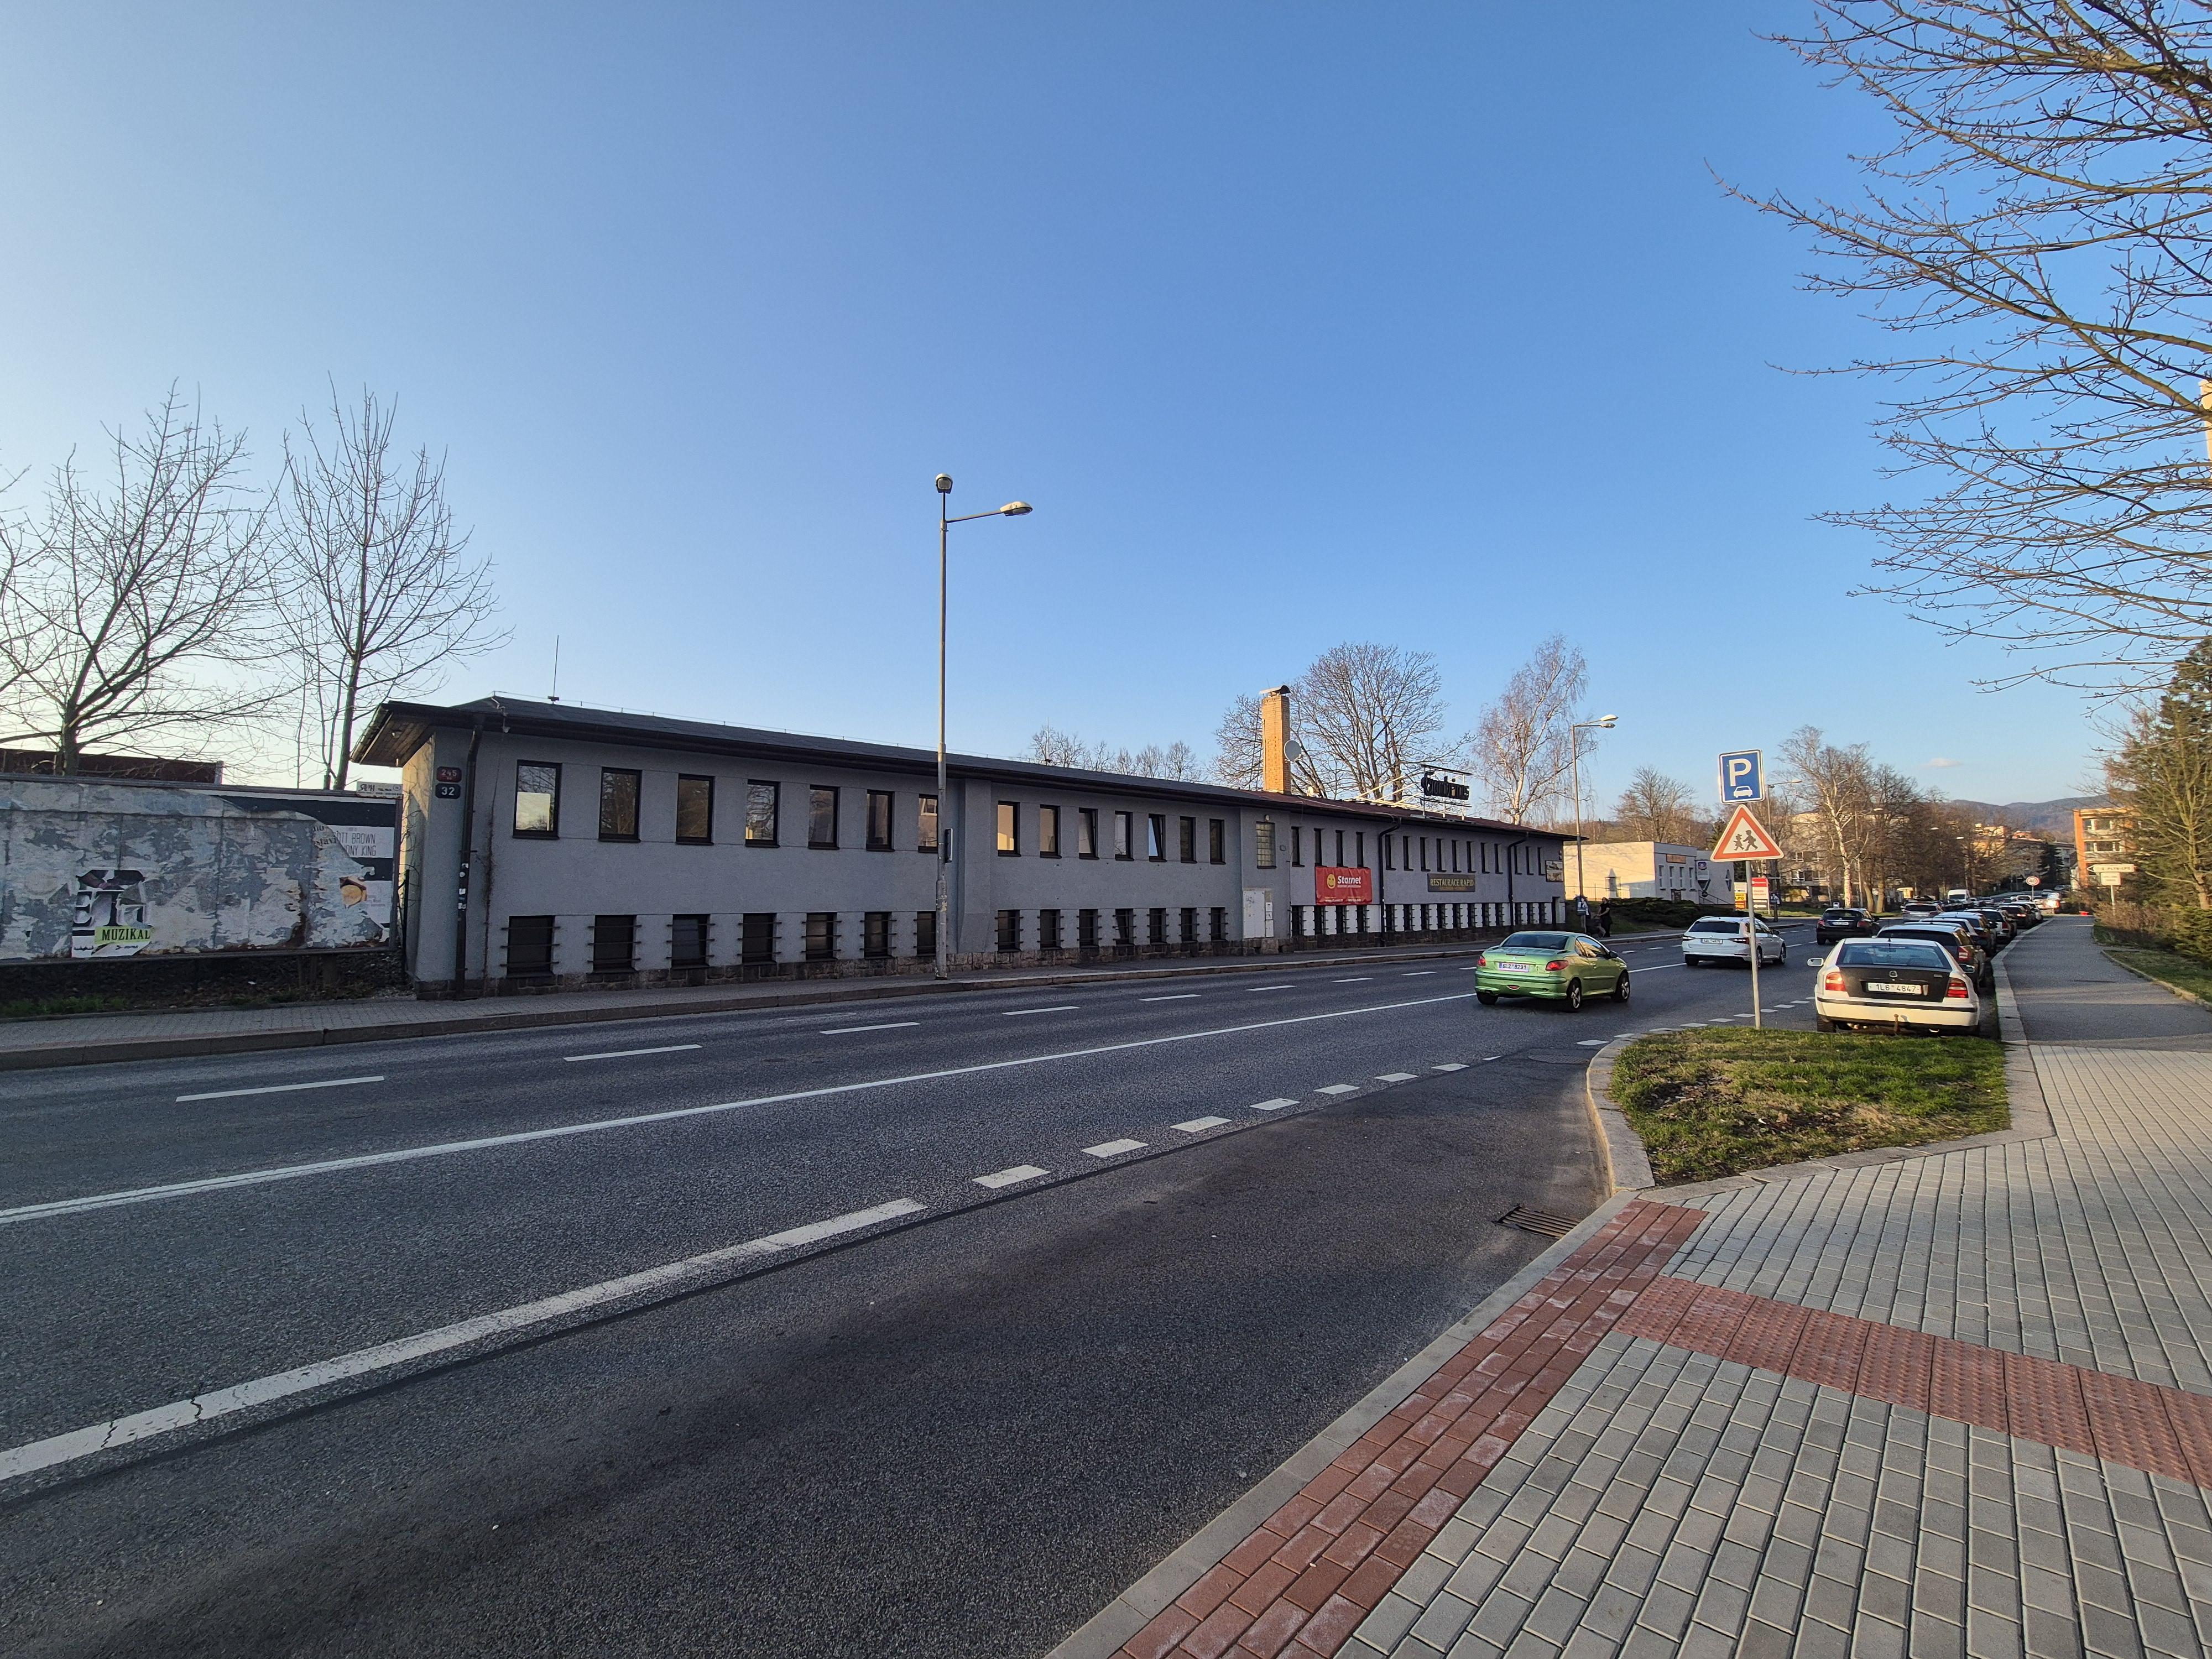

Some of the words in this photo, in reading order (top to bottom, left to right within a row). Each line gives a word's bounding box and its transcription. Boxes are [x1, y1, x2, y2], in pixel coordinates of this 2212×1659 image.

[1729, 758, 1752, 786] P
[441, 787, 455, 796] 32
[351, 833, 375, 844] BROWN
[361, 846, 376, 856] KING
[1337, 875, 1361, 884] Starnet
